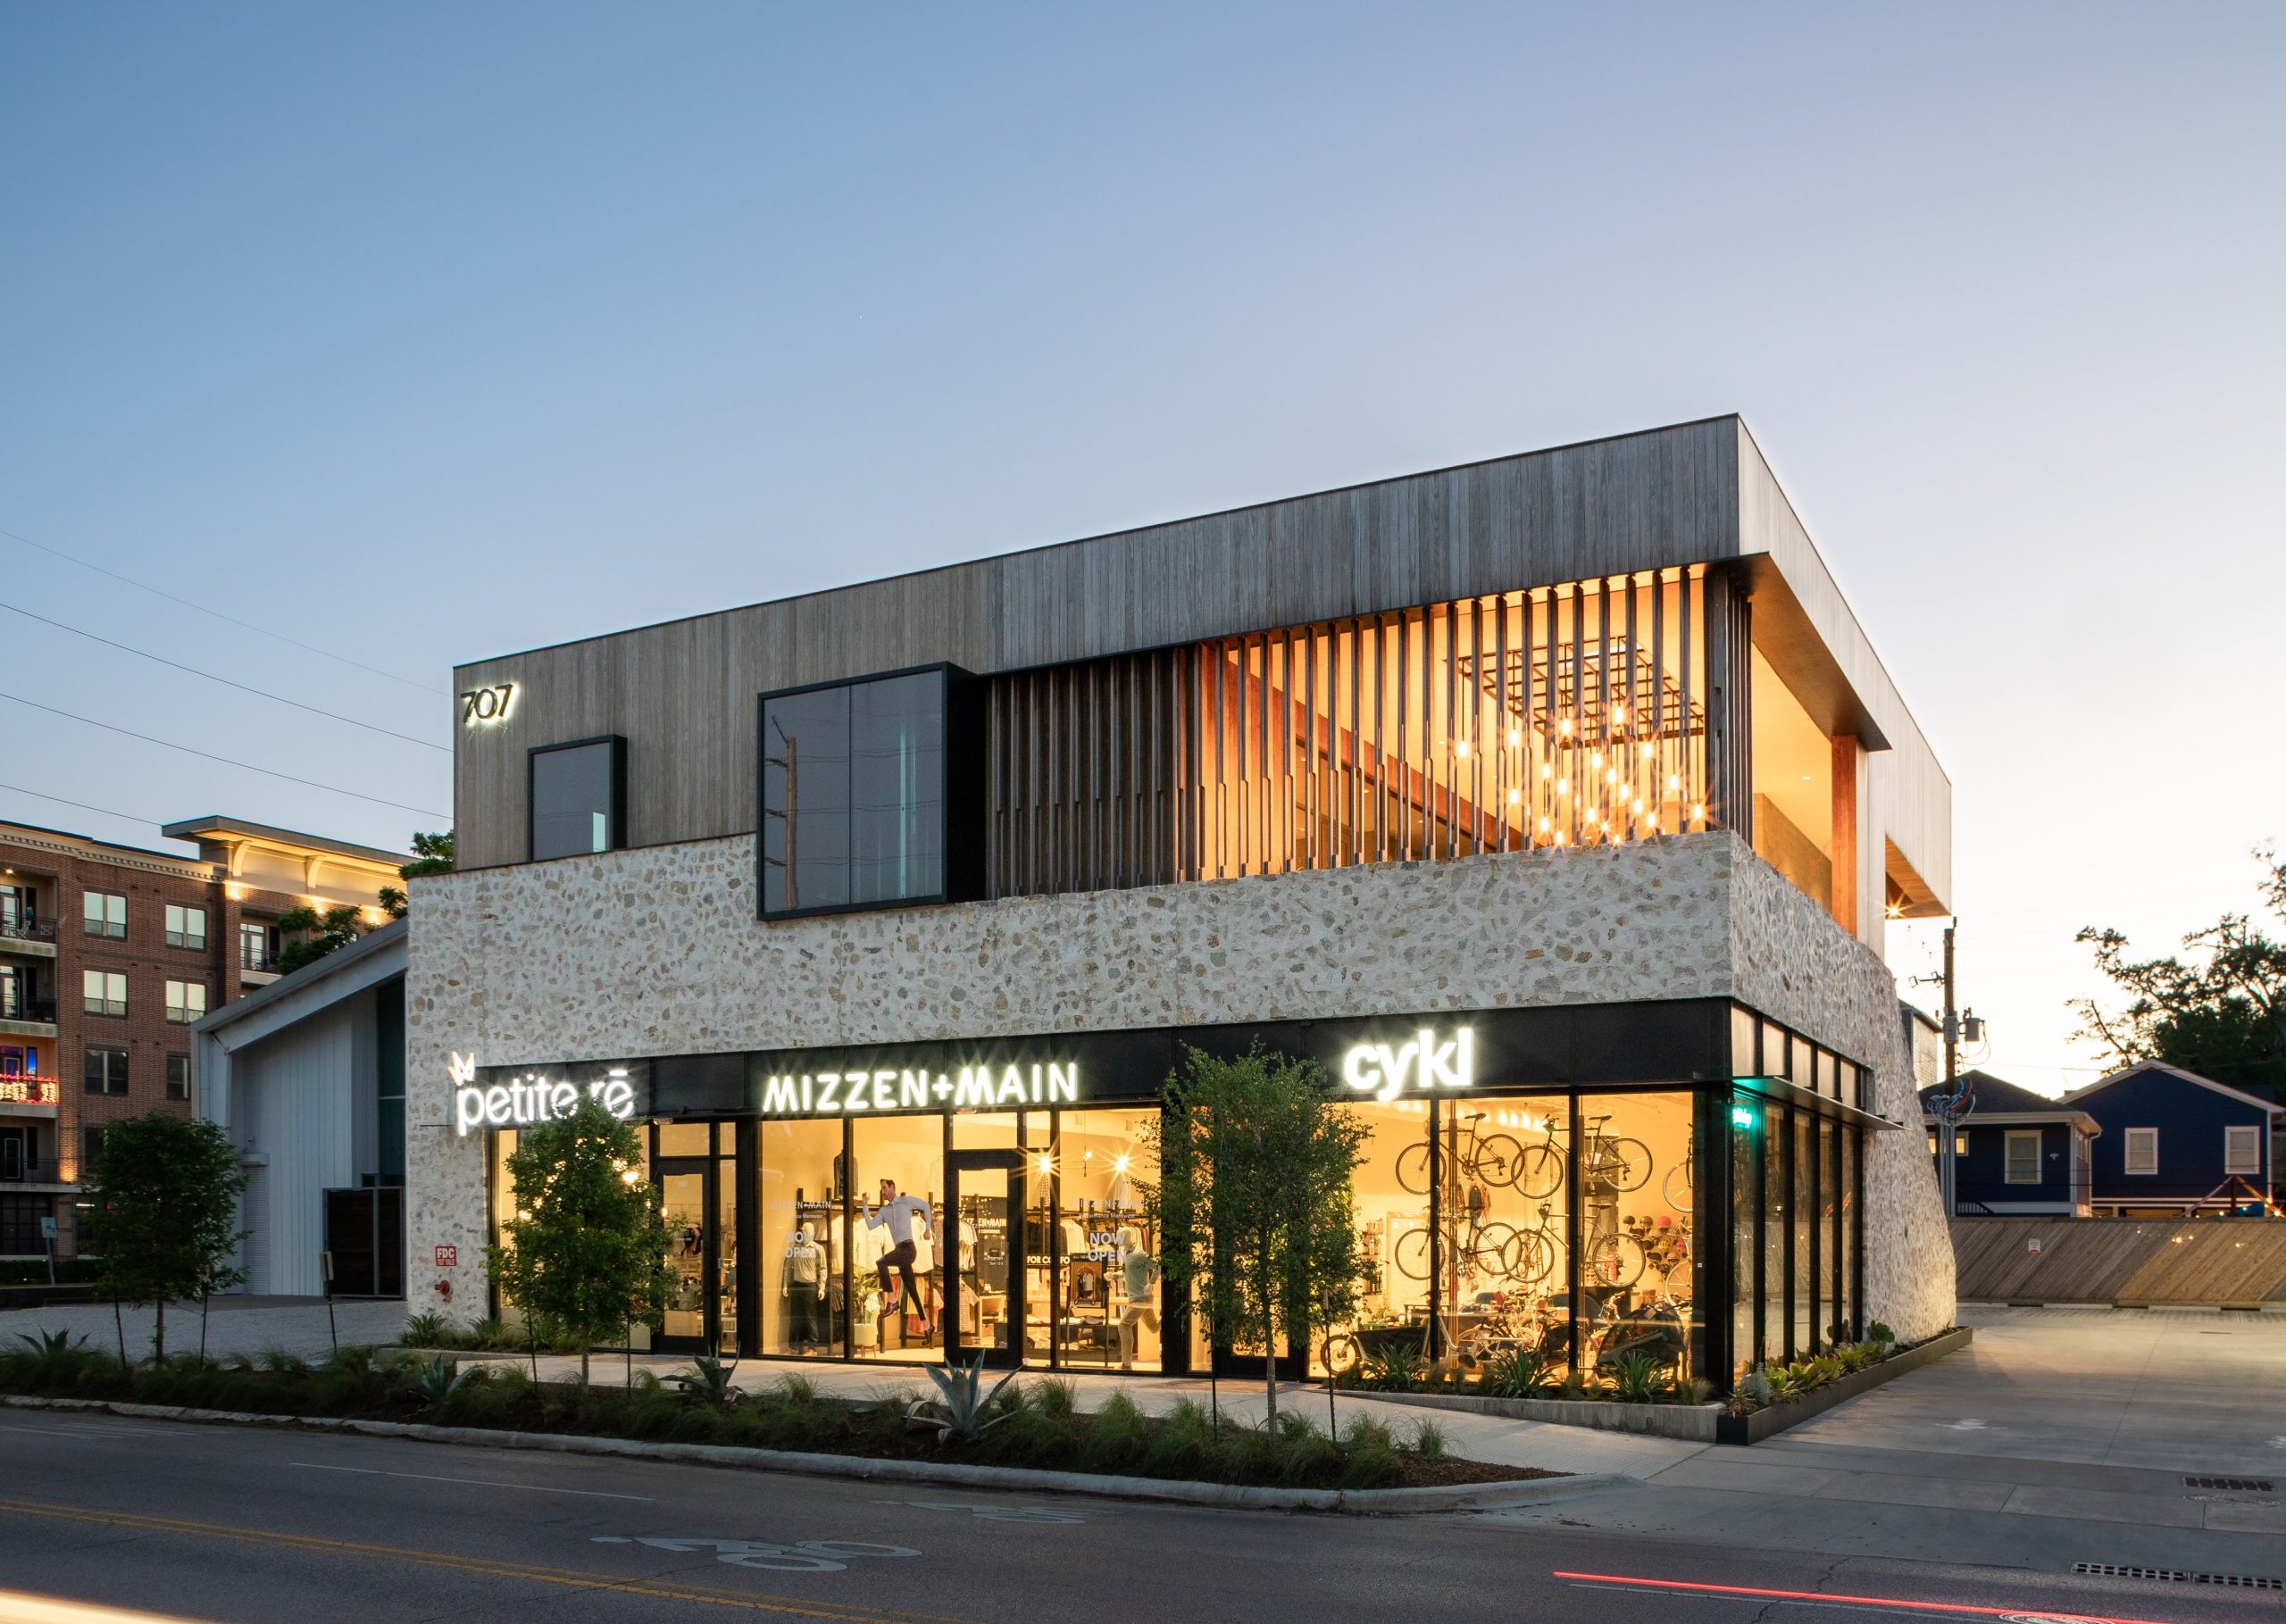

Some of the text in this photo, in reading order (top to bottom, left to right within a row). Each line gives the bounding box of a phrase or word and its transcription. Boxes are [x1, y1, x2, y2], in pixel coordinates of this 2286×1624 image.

[459, 683, 514, 724] 707
[1343, 1027, 1473, 1103] cykl
[762, 1062, 1078, 1113] MIZZEN+MAIN
[456, 1072, 579, 1137] petite
[1089, 1232, 1125, 1245] NOW
[437, 1247, 455, 1259] FDC
[783, 1246, 817, 1258] OPEN
[1088, 1250, 1127, 1262] OPEN
[1026, 1255, 1041, 1264] FOR
